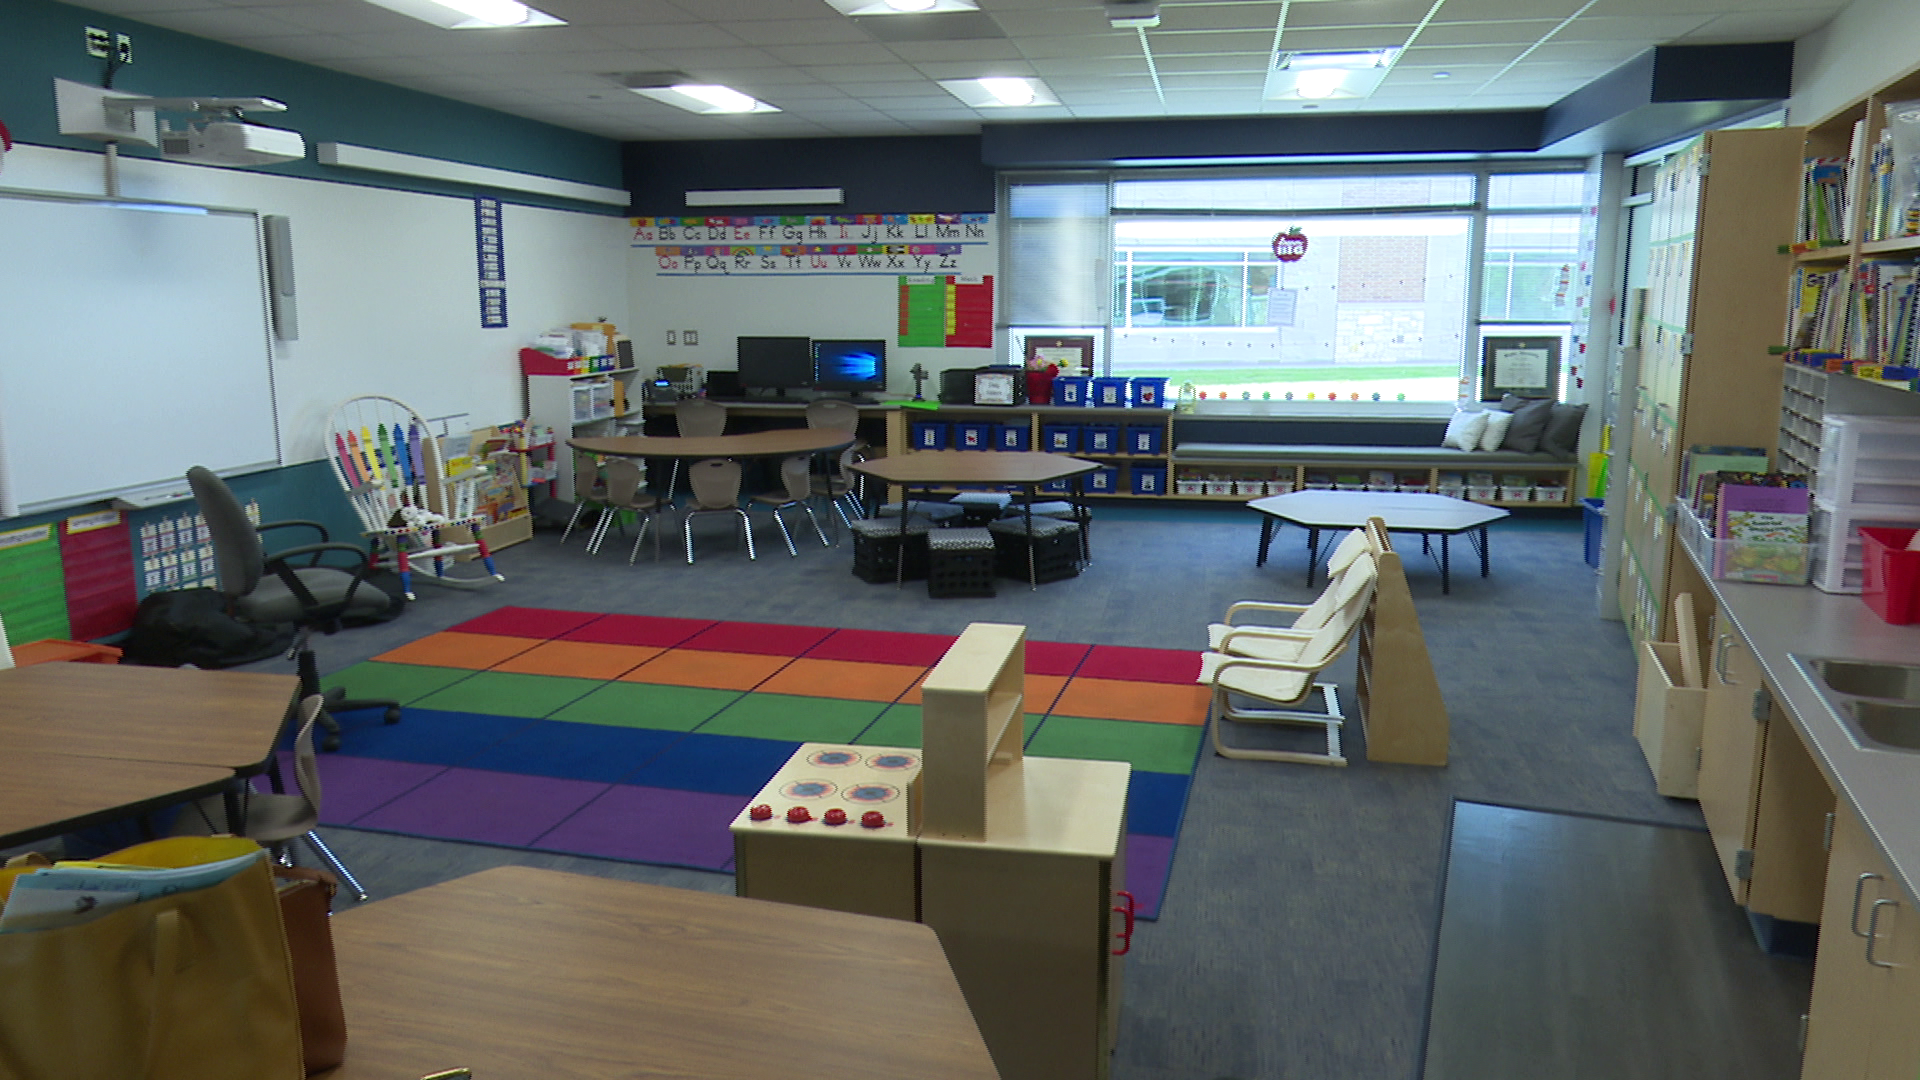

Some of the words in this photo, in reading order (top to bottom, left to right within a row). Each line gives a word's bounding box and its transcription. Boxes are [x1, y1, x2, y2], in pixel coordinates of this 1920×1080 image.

[633, 227, 654, 241] Aa
[659, 226, 677, 241] Bb
[683, 226, 702, 240] Cc
[708, 226, 727, 240] Dd
[734, 226, 751, 240] Ee
[759, 226, 777, 240] Ff
[782, 225, 804, 245] Gg
[809, 224, 827, 239] Hh
[840, 224, 848, 239] Ii
[861, 224, 878, 245] Jj
[887, 224, 904, 238] Kk
[915, 224, 928, 238] Ll
[936, 224, 960, 238] Mm
[966, 223, 985, 238] Nn
[658, 255, 679, 270] Oo
[684, 255, 702, 274] Pp
[706, 255, 731, 275] Qq
[735, 255, 751, 270] Rr
[760, 255, 777, 269] Ss
[785, 255, 802, 269] Tt
[810, 255, 828, 269] Uu
[837, 254, 852, 268] Vv
[858, 254, 882, 268] Ww
[887, 254, 905, 268] Xx
[913, 254, 932, 274] Yy
[939, 253, 958, 268] Zz
